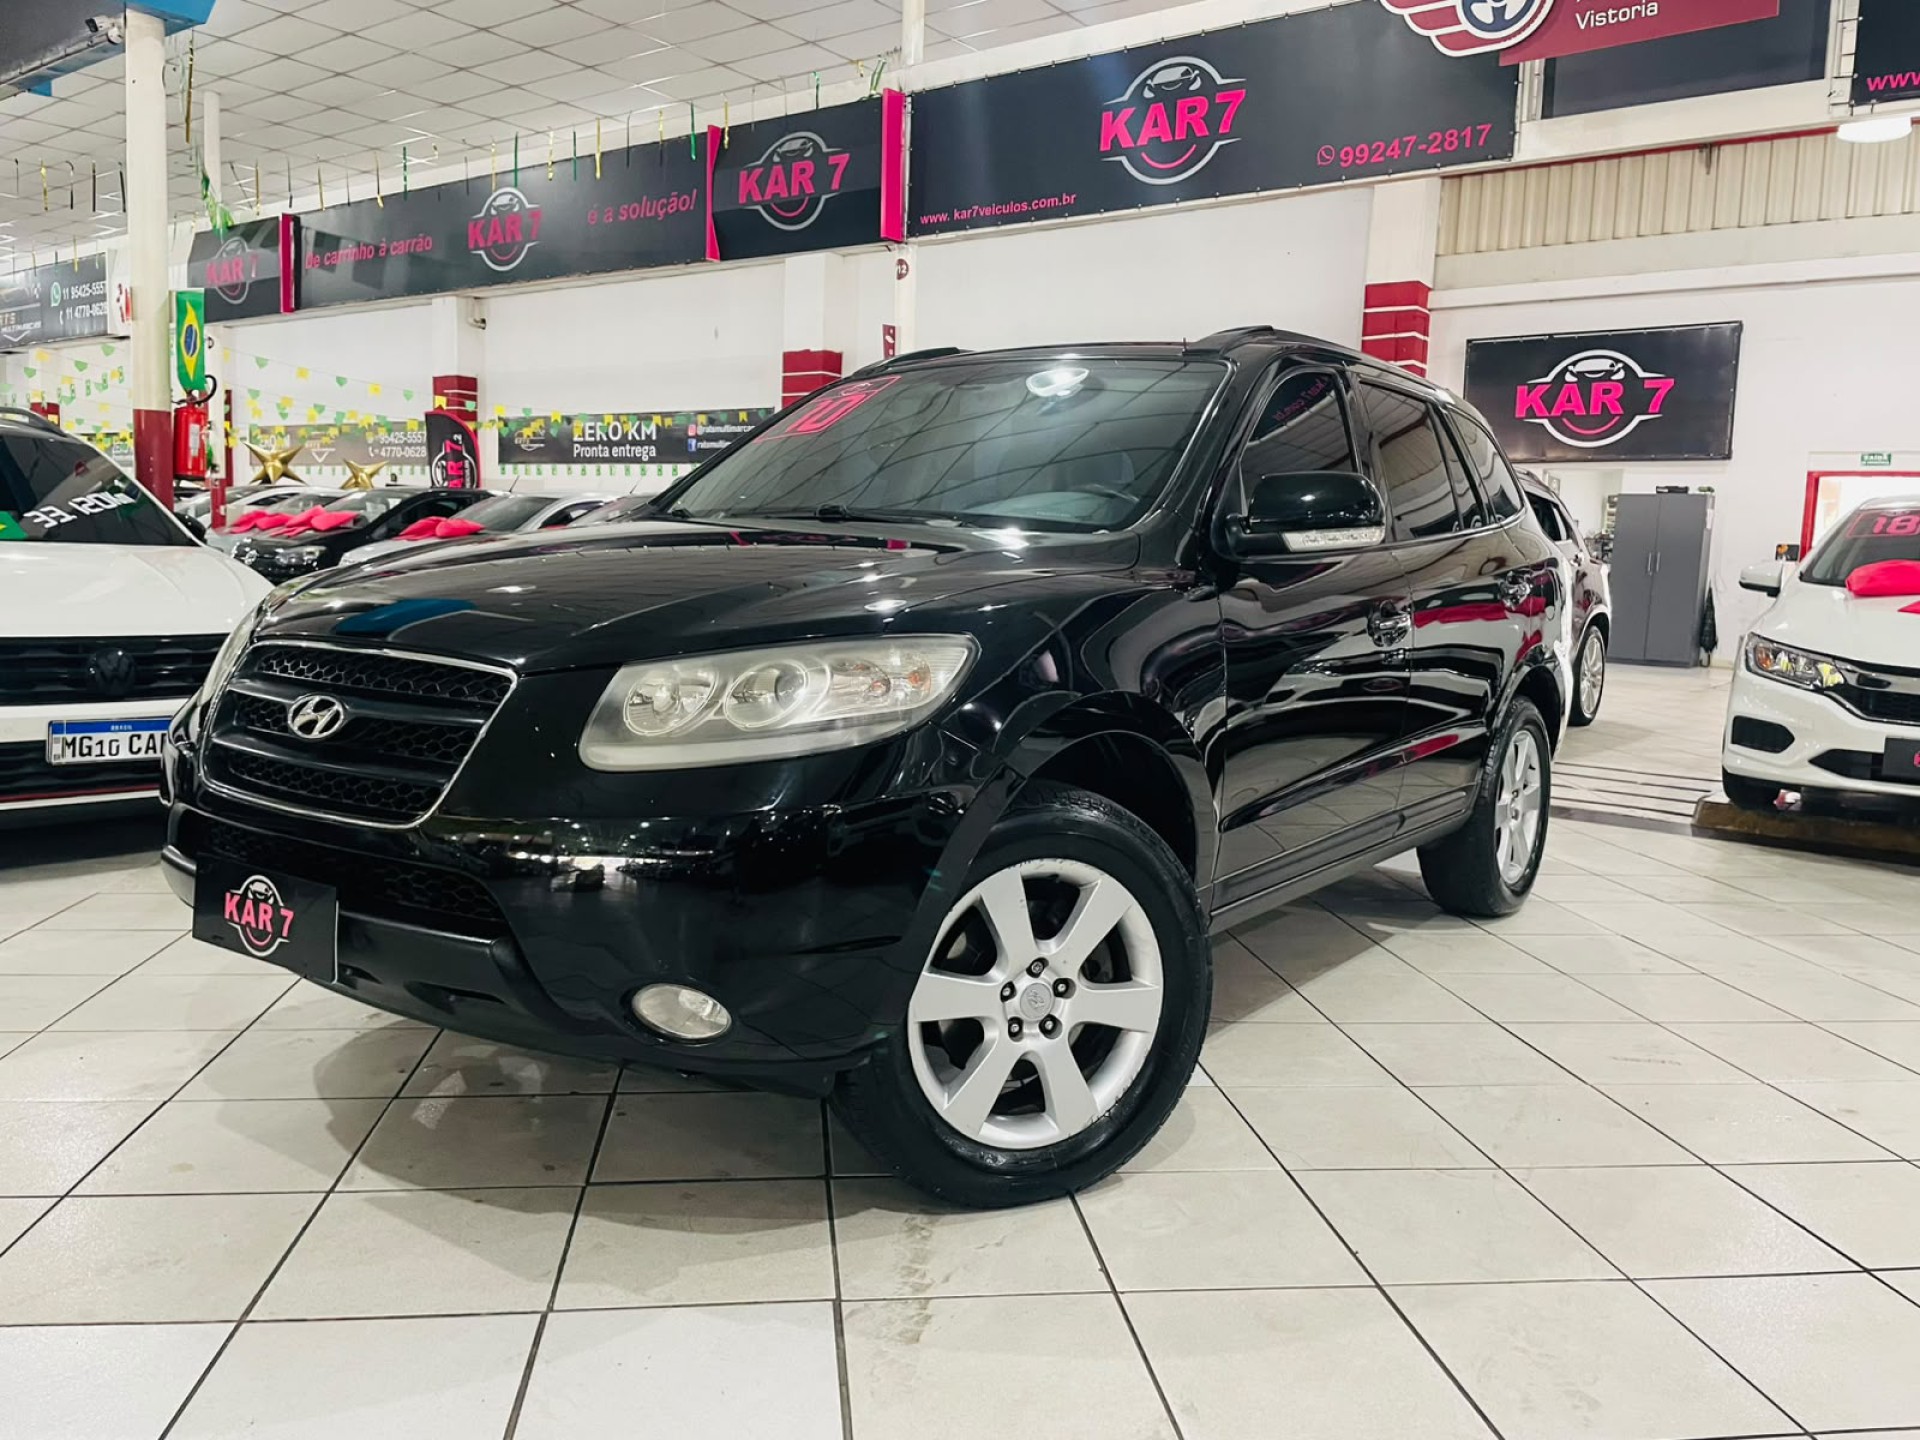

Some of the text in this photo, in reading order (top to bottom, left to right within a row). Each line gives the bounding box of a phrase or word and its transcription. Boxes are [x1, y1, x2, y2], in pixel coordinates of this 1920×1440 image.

[1575, 0, 1658, 29] Vistoria
[1100, 97, 1209, 151] KAR
[1339, 124, 1492, 167] 99247-2817
[738, 153, 850, 204] KAR 7
[588, 188, 698, 225] é a solução!
[953, 193, 1077, 221] kar7veiculos.com.br
[468, 209, 543, 250] KAR 7
[305, 251, 321, 269] De
[324, 241, 375, 265] carrinho
[390, 233, 433, 256] carrão
[206, 256, 244, 287] KAR
[1514, 378, 1675, 419] KAR 7
[628, 421, 657, 441] KM
[573, 443, 657, 461] Pronta entrega
[1873, 515, 1920, 534] 18
[62, 736, 120, 758] MG10
[224, 891, 294, 938] KAR 7
